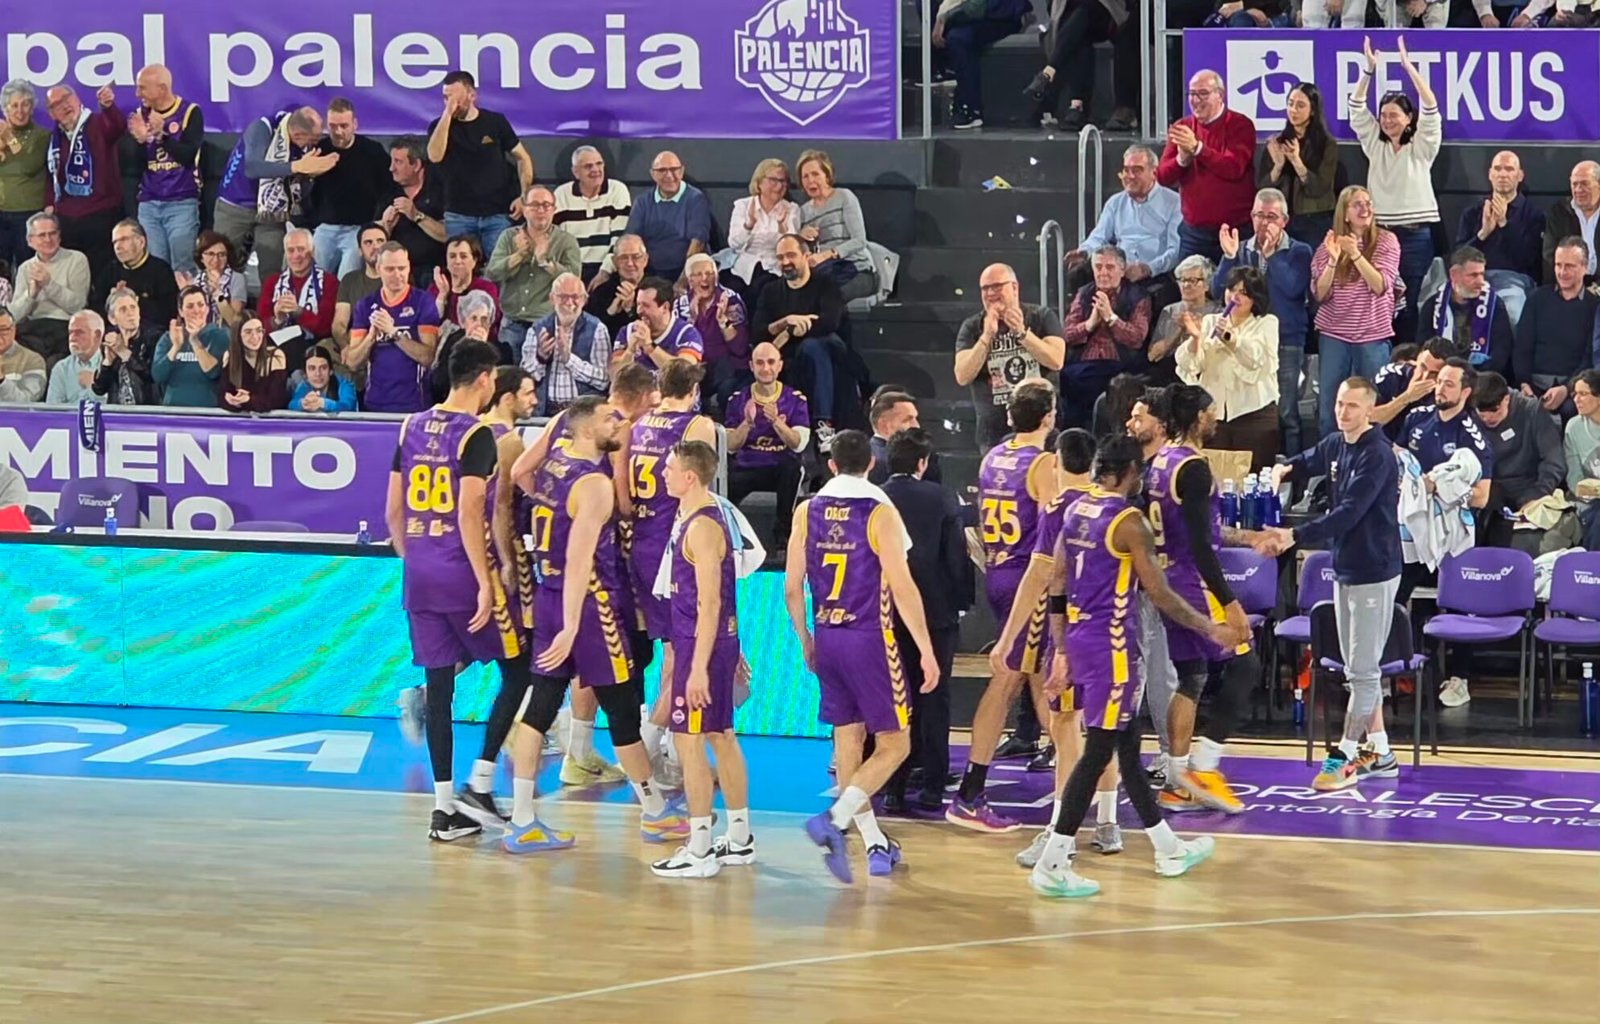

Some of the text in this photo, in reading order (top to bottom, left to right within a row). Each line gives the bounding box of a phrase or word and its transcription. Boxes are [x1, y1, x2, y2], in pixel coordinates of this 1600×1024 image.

[209, 13, 702, 102] palencia
[741, 37, 864, 73] PALENCIA
[1336, 50, 1565, 122] PETKUS
[0, 427, 356, 490] MIENTO
[629, 454, 660, 499] 13
[78, 496, 112, 507] Villanova
[407, 464, 454, 513] 88
[980, 498, 1021, 545] 35
[821, 553, 848, 601] 7
[1461, 570, 1502, 581] Villanova
